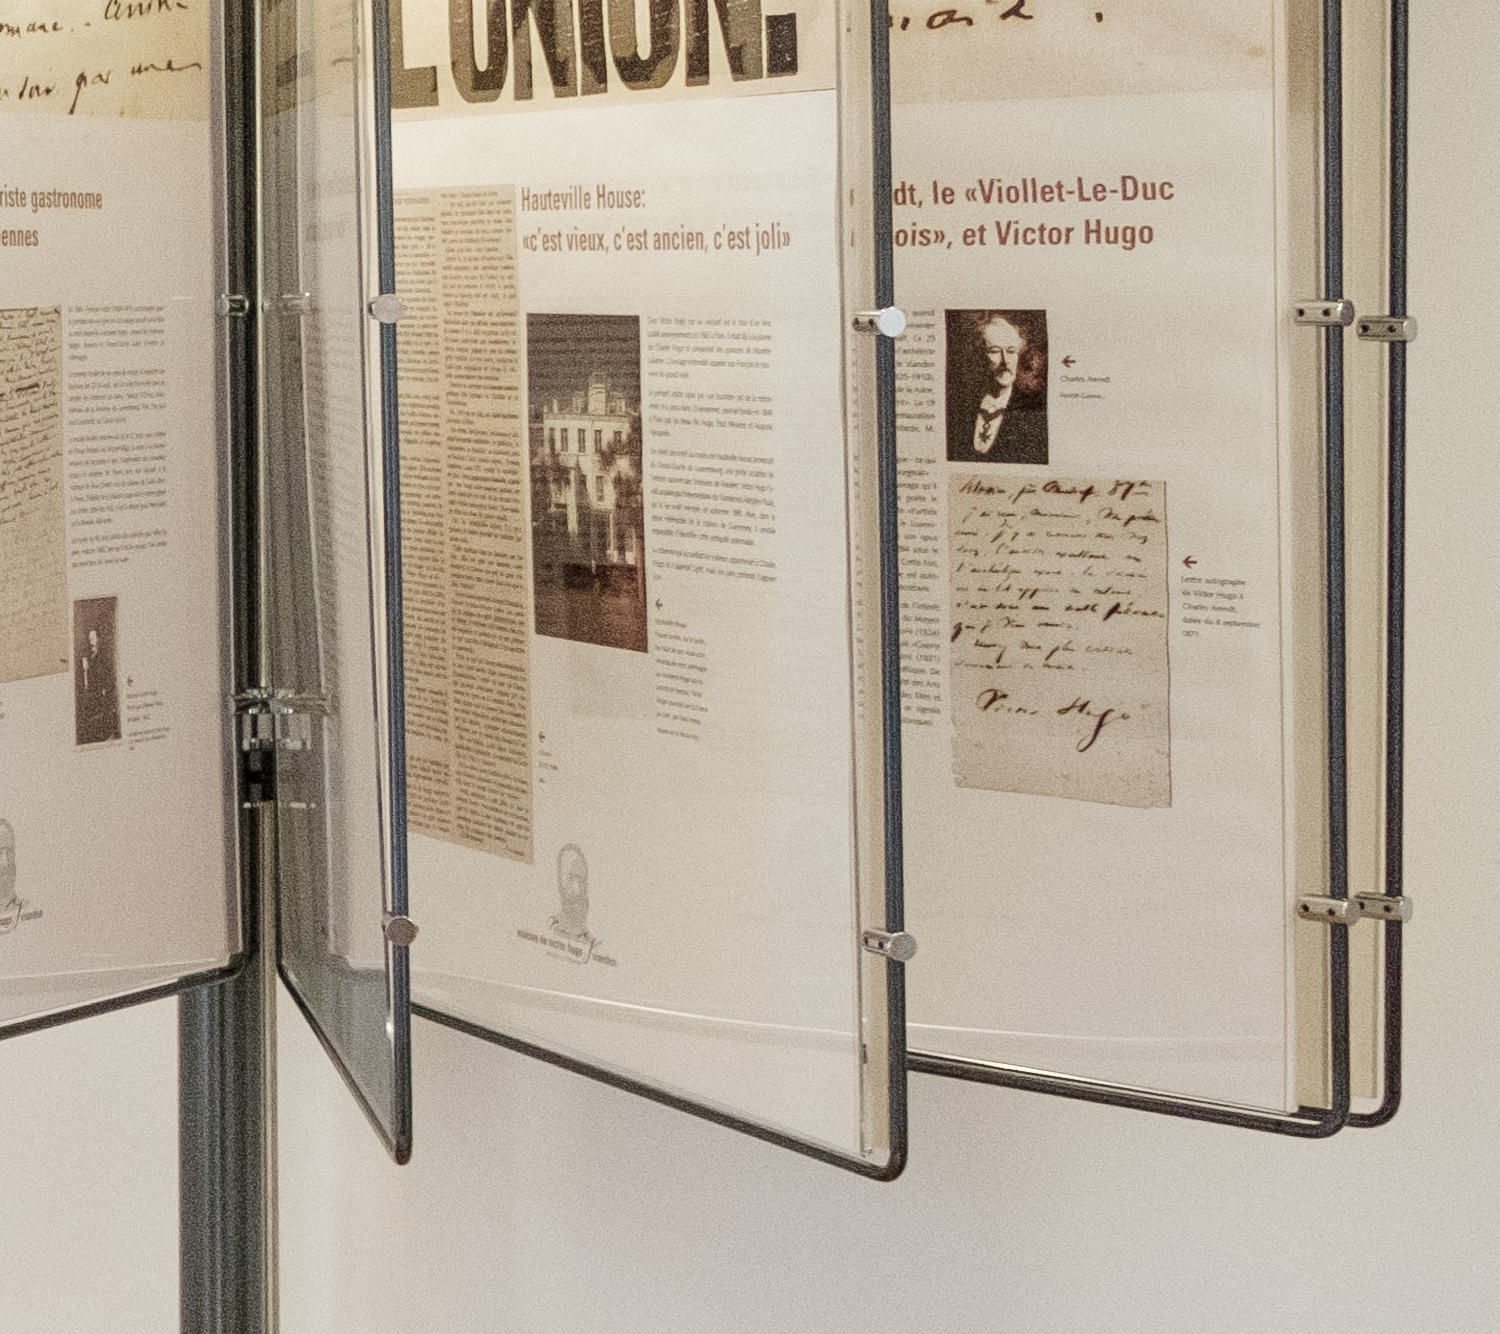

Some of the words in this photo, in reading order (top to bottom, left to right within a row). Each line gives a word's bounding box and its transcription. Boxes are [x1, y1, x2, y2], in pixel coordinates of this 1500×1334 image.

[31, 188, 103, 214] gastronome
[521, 185, 591, 212] Hauteville
[596, 184, 647, 210] House:
[894, 181, 924, 209] dt,
[933, 180, 956, 205] le
[965, 174, 1175, 205] «Viollet-Le-Duc
[523, 227, 563, 253] «c'est
[566, 225, 609, 255] vieux,
[613, 225, 648, 252] c'est
[653, 224, 709, 254] ancien,
[713, 222, 751, 252] c'est
[755, 221, 791, 256] joli»
[894, 222, 952, 249] ois»,
[962, 224, 987, 246] et
[995, 219, 1074, 246] Victor
[1084, 219, 1154, 251] Hugo
